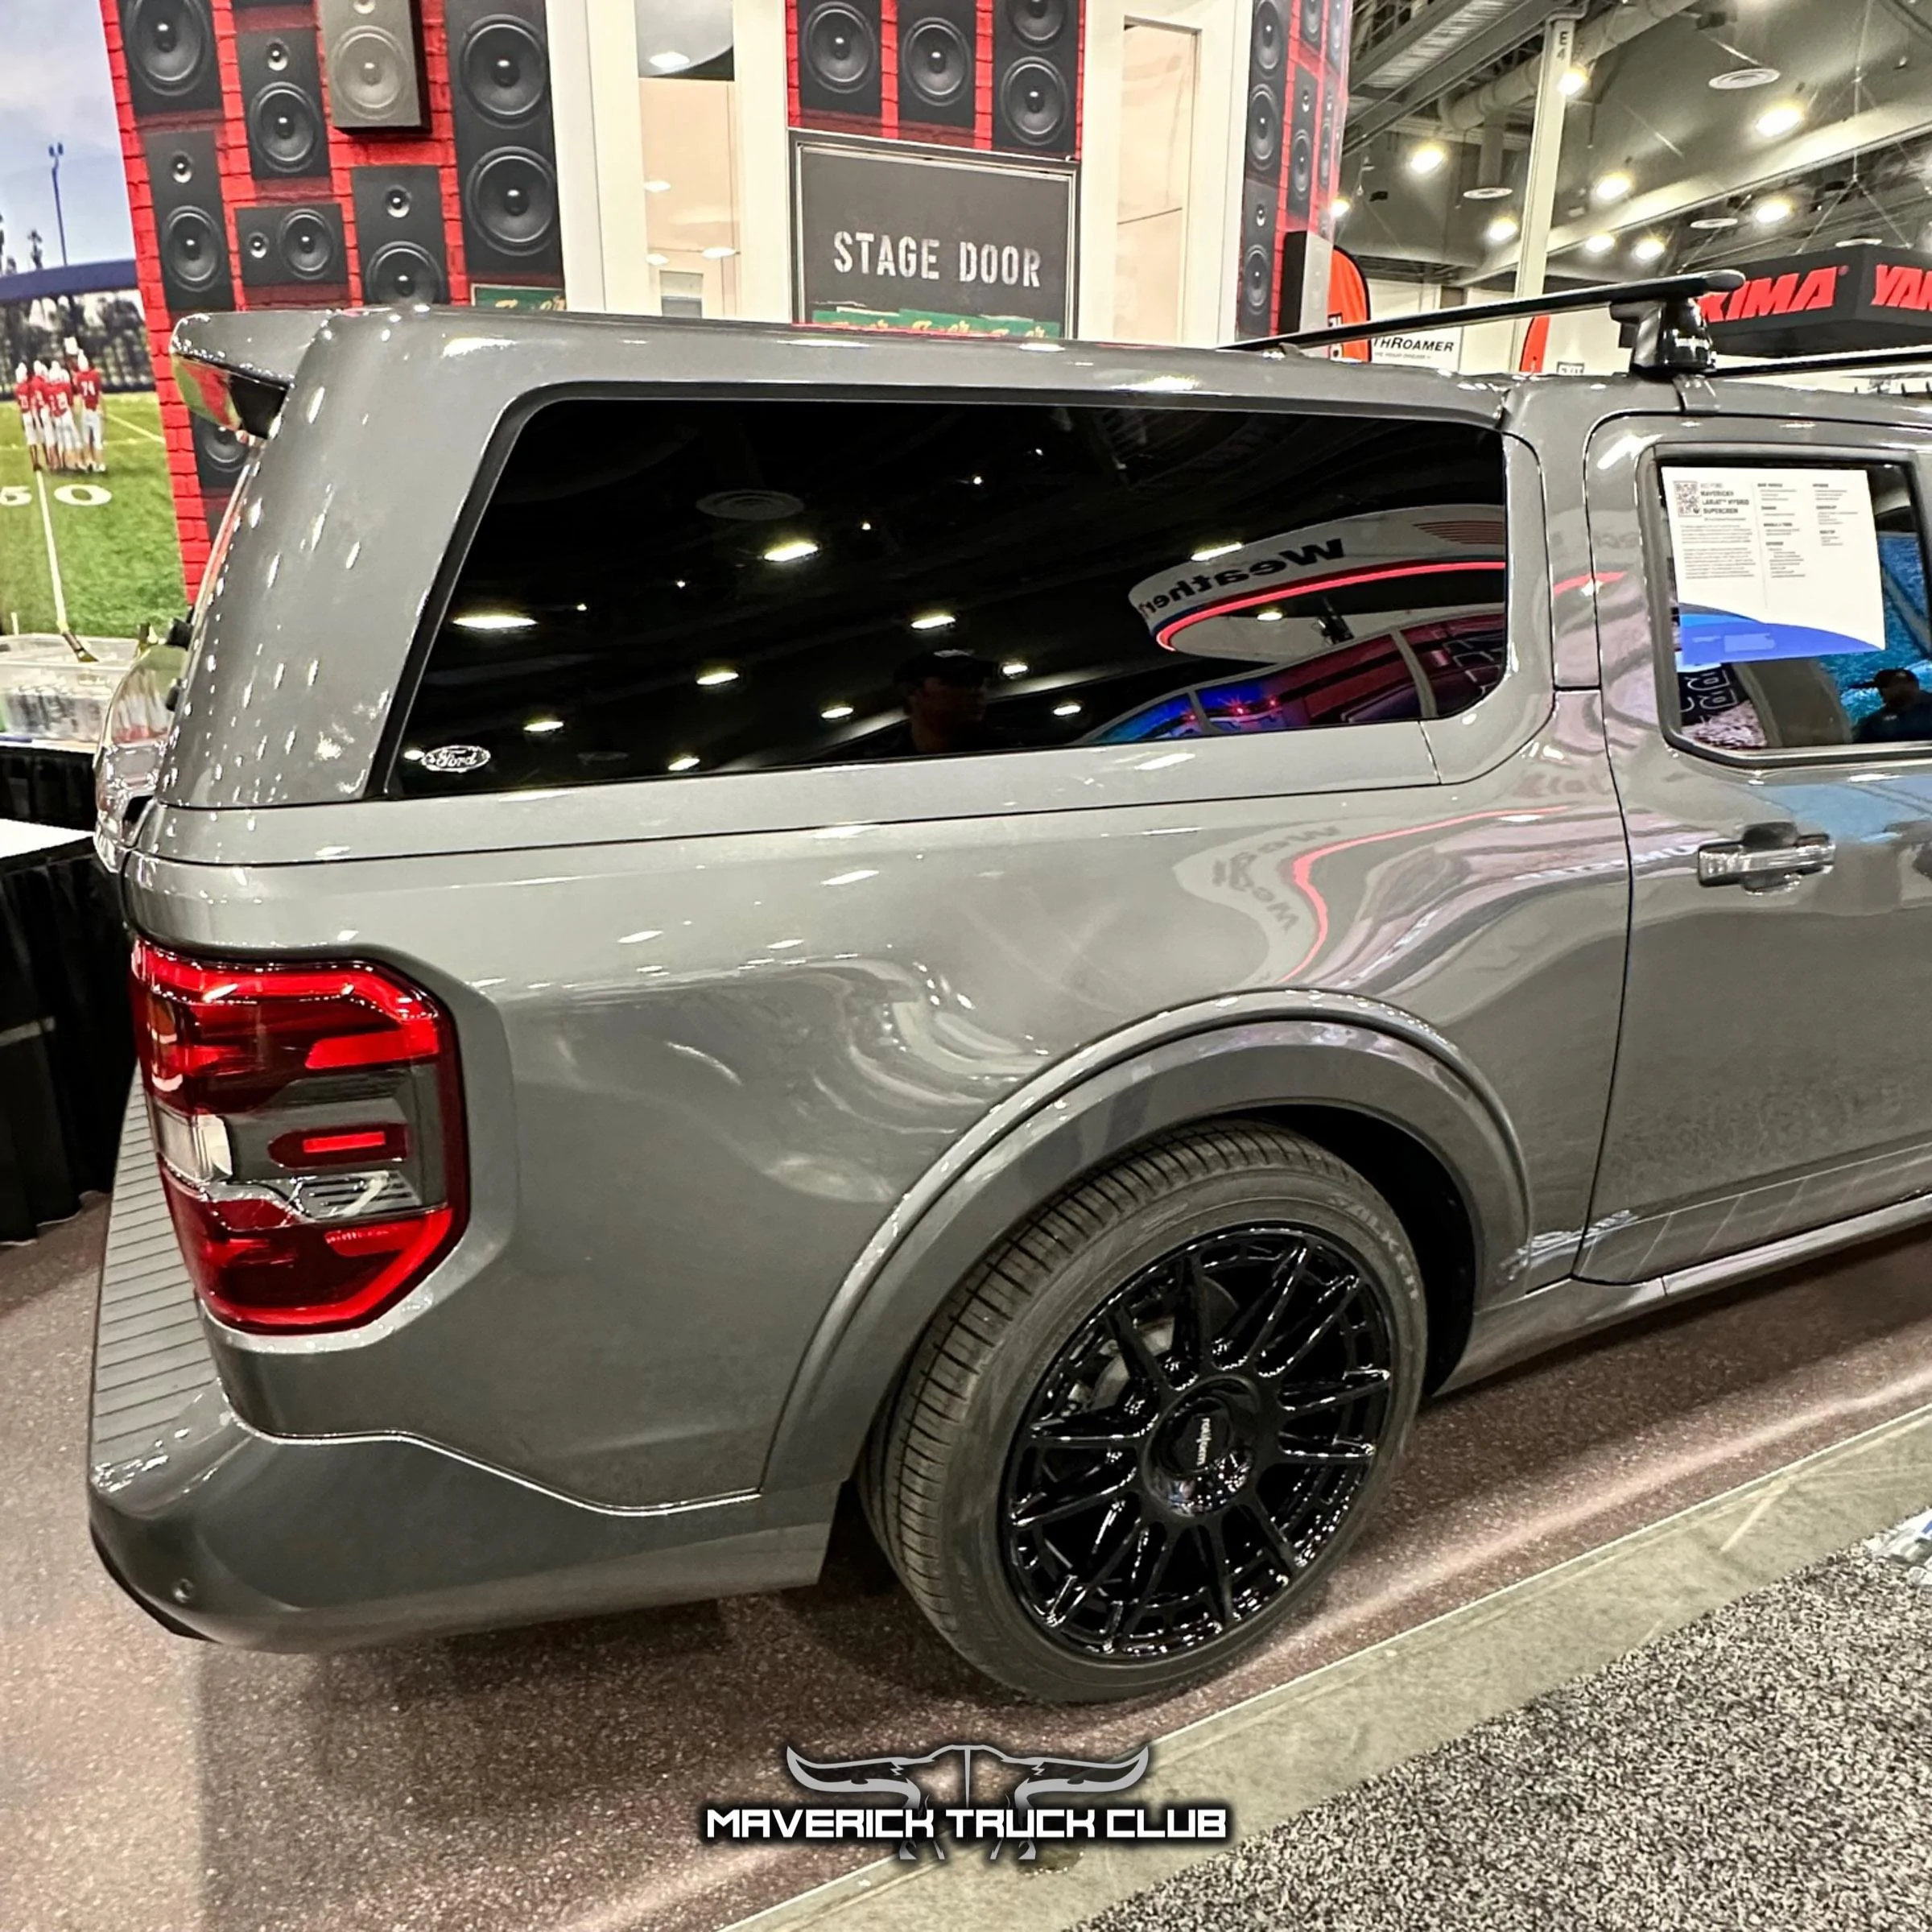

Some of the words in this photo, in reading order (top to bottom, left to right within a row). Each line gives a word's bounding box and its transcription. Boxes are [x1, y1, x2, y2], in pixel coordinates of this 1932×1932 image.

[1558, 31, 1569, 45] E
[834, 231, 940, 280] STAGE
[960, 242, 1041, 287] DOOR
[1696, 266, 1837, 322] KIMA
